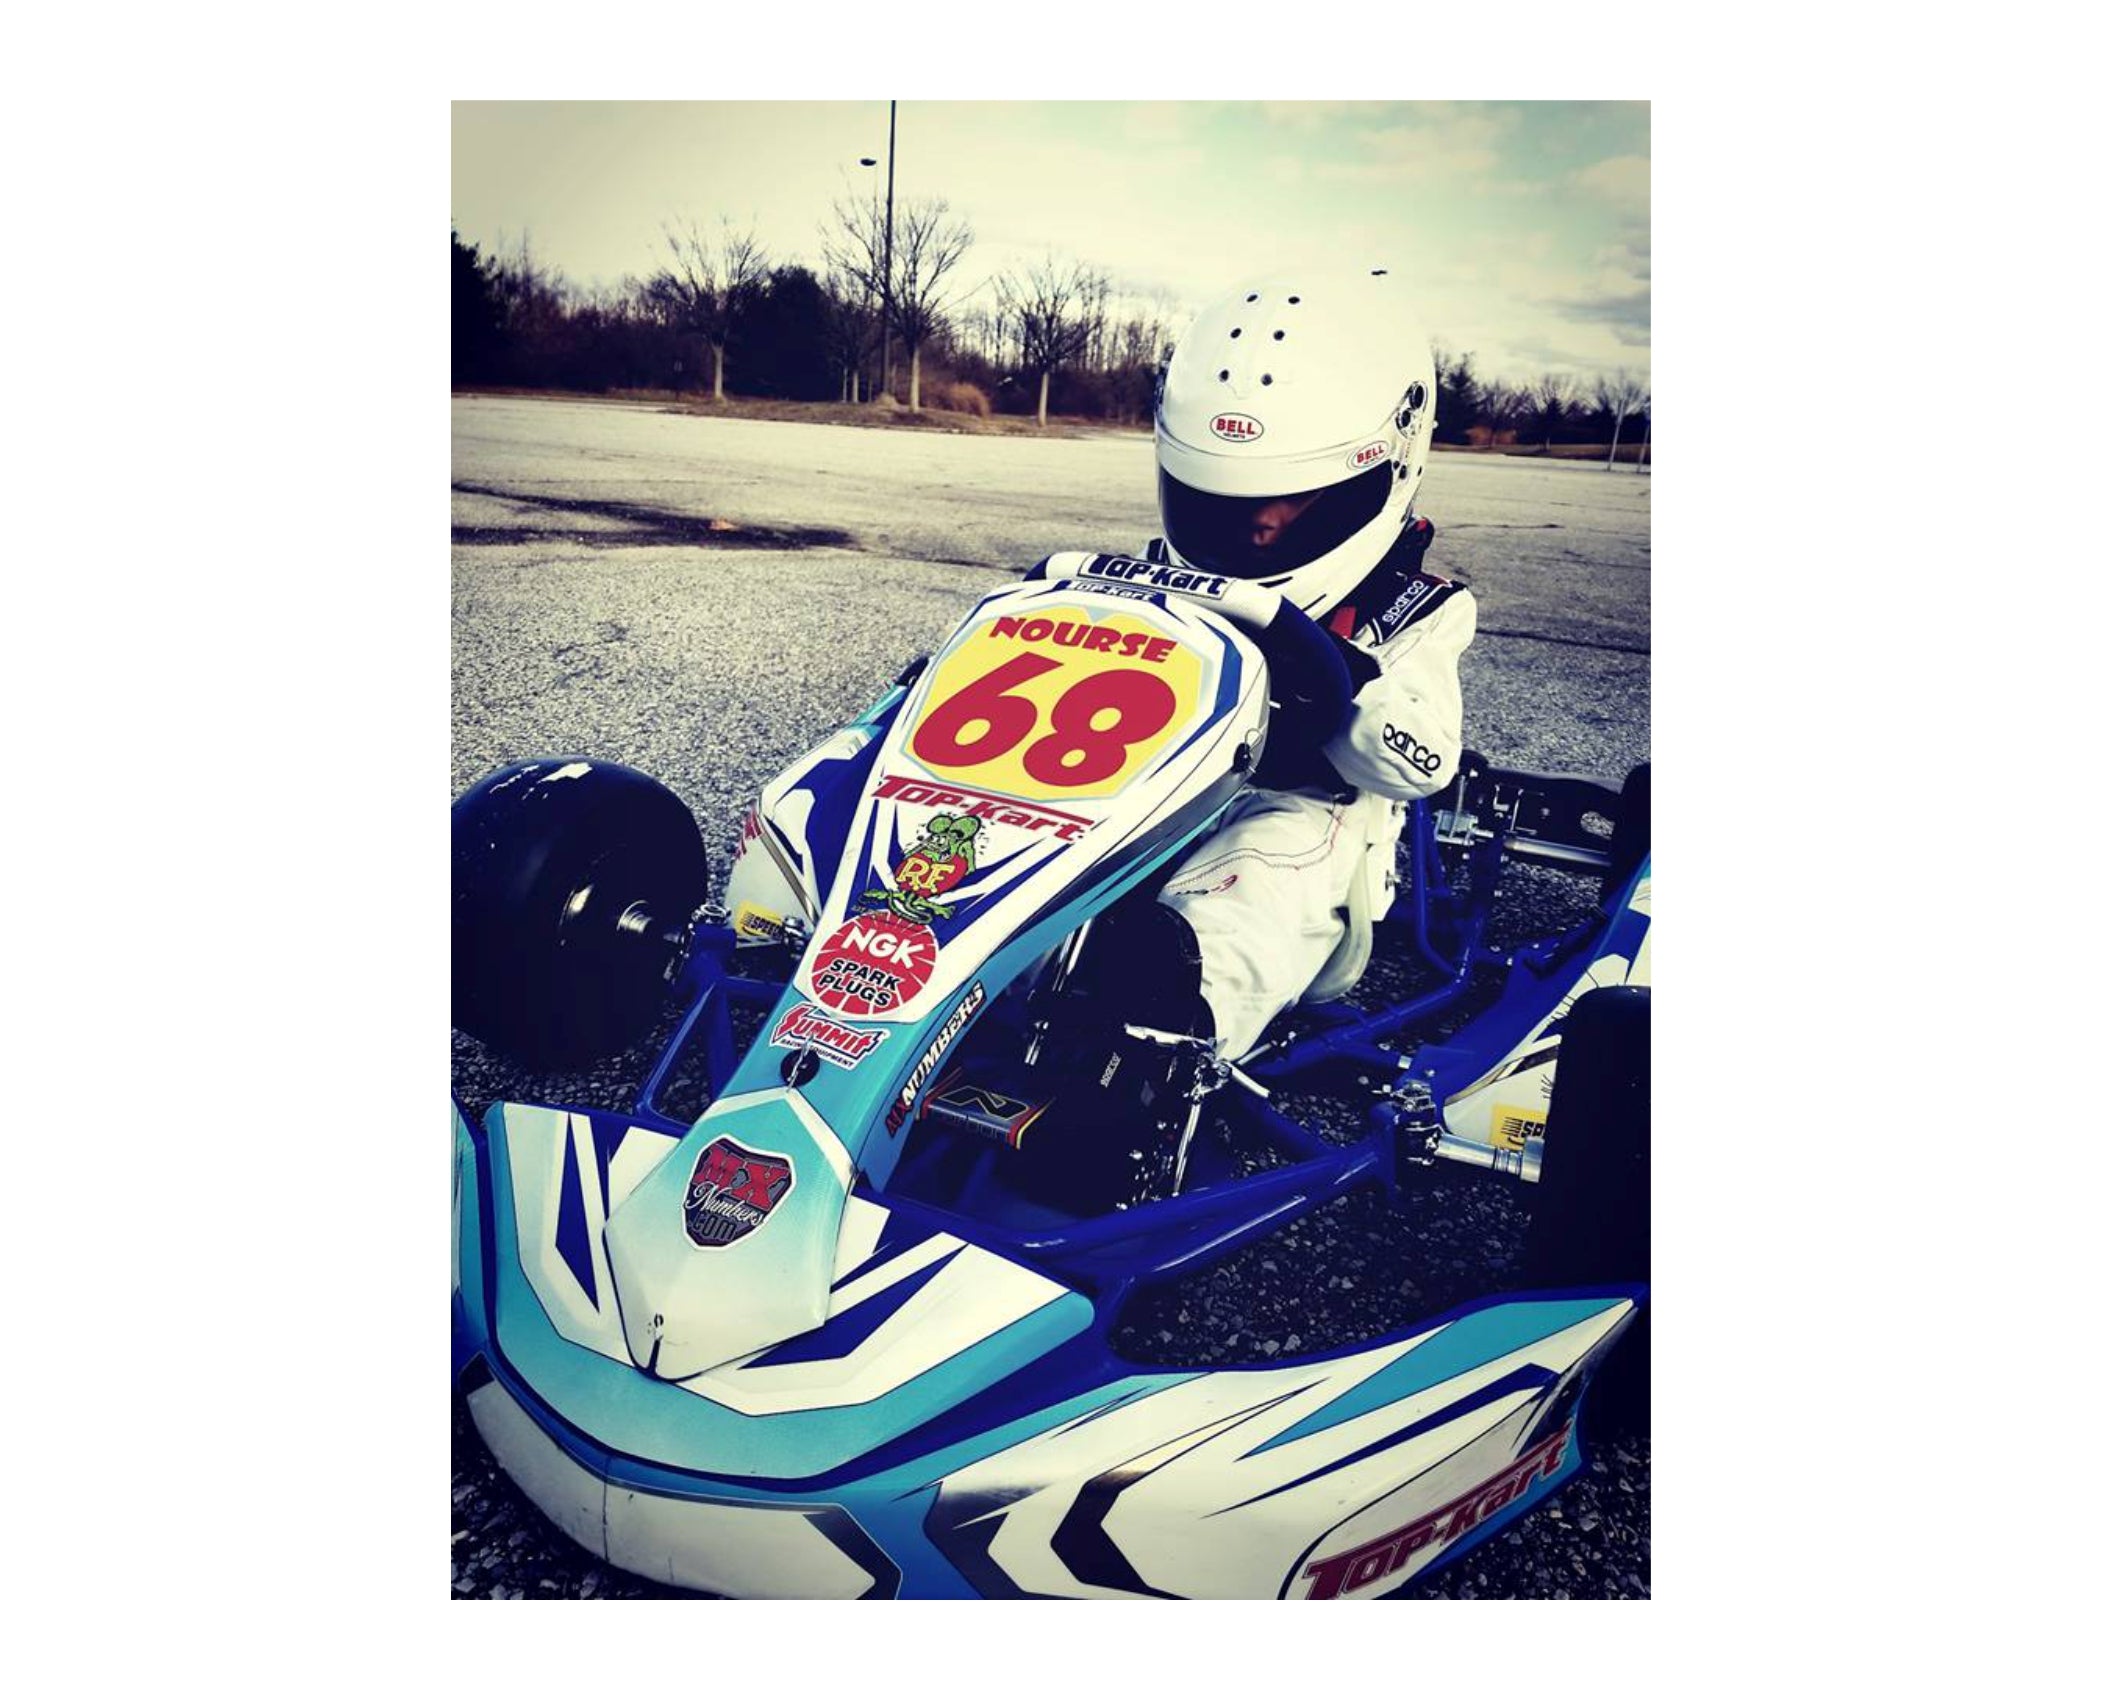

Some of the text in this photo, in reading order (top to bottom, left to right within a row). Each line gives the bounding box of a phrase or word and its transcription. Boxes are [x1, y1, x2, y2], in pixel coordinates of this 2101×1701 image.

[1216, 418, 1255, 435] BELL
[1357, 445, 1384, 464] BELL
[989, 616, 1178, 663] NOURSE
[912, 651, 1177, 787] 68
[1383, 722, 1441, 778] parco
[843, 926, 924, 969] NGK
[818, 974, 892, 1007] PLUGS
[830, 959, 901, 992] SPARK
[774, 1005, 874, 1055] SUMMIT
[692, 1143, 792, 1212] MX
[685, 1181, 763, 1226] Numbers
